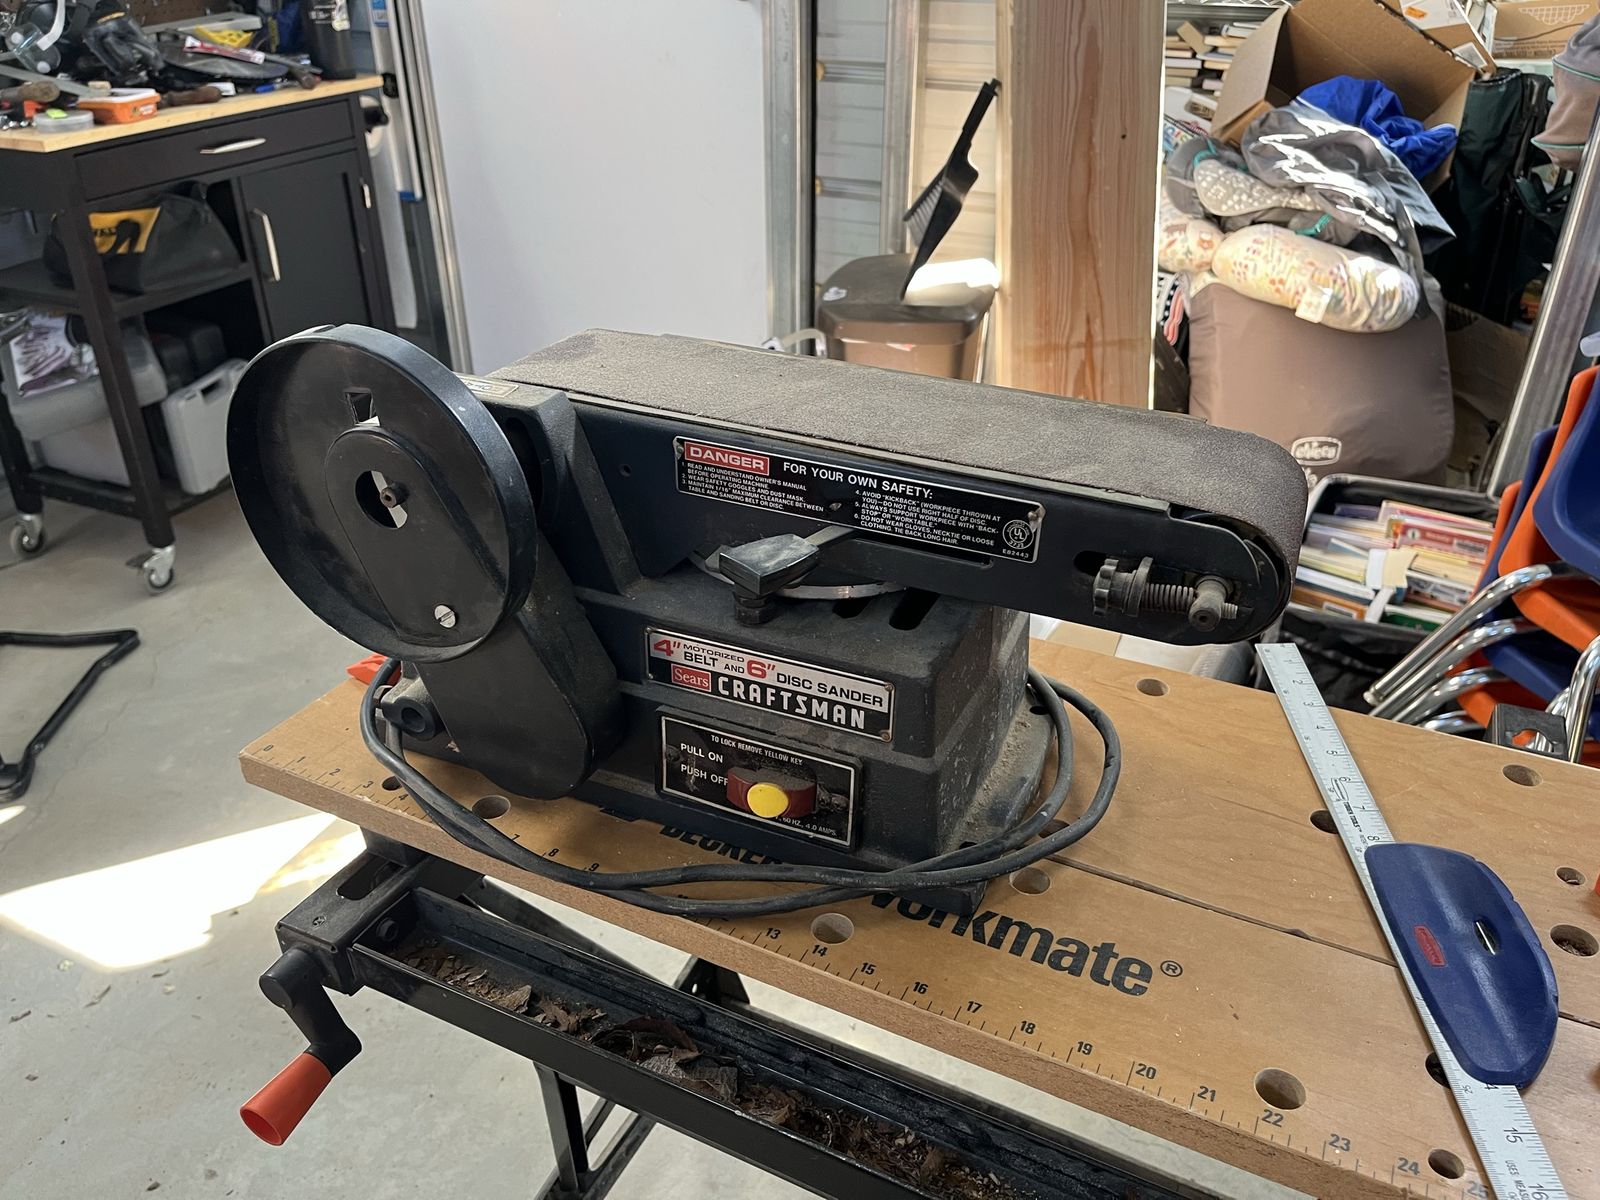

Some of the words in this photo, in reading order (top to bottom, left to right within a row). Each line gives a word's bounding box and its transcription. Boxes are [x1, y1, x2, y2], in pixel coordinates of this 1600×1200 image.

[690, 447, 764, 470] DANGER
[688, 469, 709, 478] BEFORE
[710, 473, 742, 484] OPERATING
[742, 479, 770, 489] MACHINE.
[704, 465, 715, 473] AND
[716, 468, 754, 481] UNDERSTAND
[755, 475, 781, 485] OWNER'S
[782, 481, 807, 491] MANUAL
[705, 477, 727, 487] SAFETY
[728, 481, 756, 493] GOGGLES
[770, 490, 785, 498] DUST
[783, 462, 806, 475] FOR
[811, 467, 843, 482] YOUR
[848, 474, 877, 489] OWN
[882, 481, 933, 499] SAFETY:
[688, 480, 715, 490] MAINTAIN
[732, 488, 759, 499] MAXIMUM
[760, 493, 794, 506] CLEARANCE
[795, 501, 824, 512] BETWEEN
[688, 486, 705, 494] TABLE
[719, 491, 744, 502] SANDING
[745, 497, 759, 505] BELT
[769, 502, 784, 510] DISC.
[862, 491, 882, 499] AVOID
[882, 494, 920, 506] "KICKBACK"
[920, 502, 961, 515] (WORKPIECE
[962, 509, 991, 521] THROWN
[861, 503, 888, 513] ALWAYS
[889, 508, 918, 519] SUPPORT
[919, 513, 956, 526] WORKPIECE
[958, 521, 975, 529] WITH
[893, 503, 907, 511] NOT
[908, 506, 921, 514] USE
[921, 508, 941, 517] RIGHT
[942, 512, 958, 521] HALF
[970, 517, 988, 526] DISC.
[871, 517, 885, 525] NOT
[886, 519, 904, 528] WEAR
[933, 529, 961, 540] NECKTIE
[972, 536, 995, 546] LOOSE
[904, 529, 922, 538] BACK
[923, 533, 941, 541] LONG
[683, 644, 745, 662] MOTORIZED
[683, 651, 719, 668] BELT
[723, 663, 745, 675] AND
[776, 672, 813, 689] DISC
[817, 683, 884, 707] SANDER
[674, 668, 709, 688] Sears
[718, 676, 865, 729] CRAFTSMAN
[680, 743, 705, 758] PULL
[708, 751, 723, 763] ON
[711, 734, 720, 743] TO
[721, 737, 736, 748] LOCK
[738, 740, 763, 755] REMOVE
[764, 749, 789, 761] YELLOW
[790, 755, 803, 766] KEY
[680, 764, 707, 780] PUSH
[710, 774, 728, 786] OFF
[329, 768, 341, 776] 2
[548, 848, 560, 857] 8
[588, 862, 600, 872] 9
[766, 928, 781, 940] 13
[812, 944, 828, 957] 14
[860, 962, 876, 975] 15
[912, 982, 928, 994] 16
[966, 1001, 982, 1013] 17
[1020, 1021, 1036, 1035] 18
[1076, 1041, 1093, 1056] 19
[1135, 1063, 1157, 1080] 20
[1196, 1086, 1216, 1102] 21
[1261, 1109, 1284, 1128] 22
[1328, 1133, 1350, 1152] 23
[1397, 1157, 1420, 1176] 24
[1467, 1180, 1489, 1199] 25
[1504, 1127, 1524, 1143] 15
[1528, 1184, 1549, 1200] 16
[1505, 1160, 1520, 1176] USES
